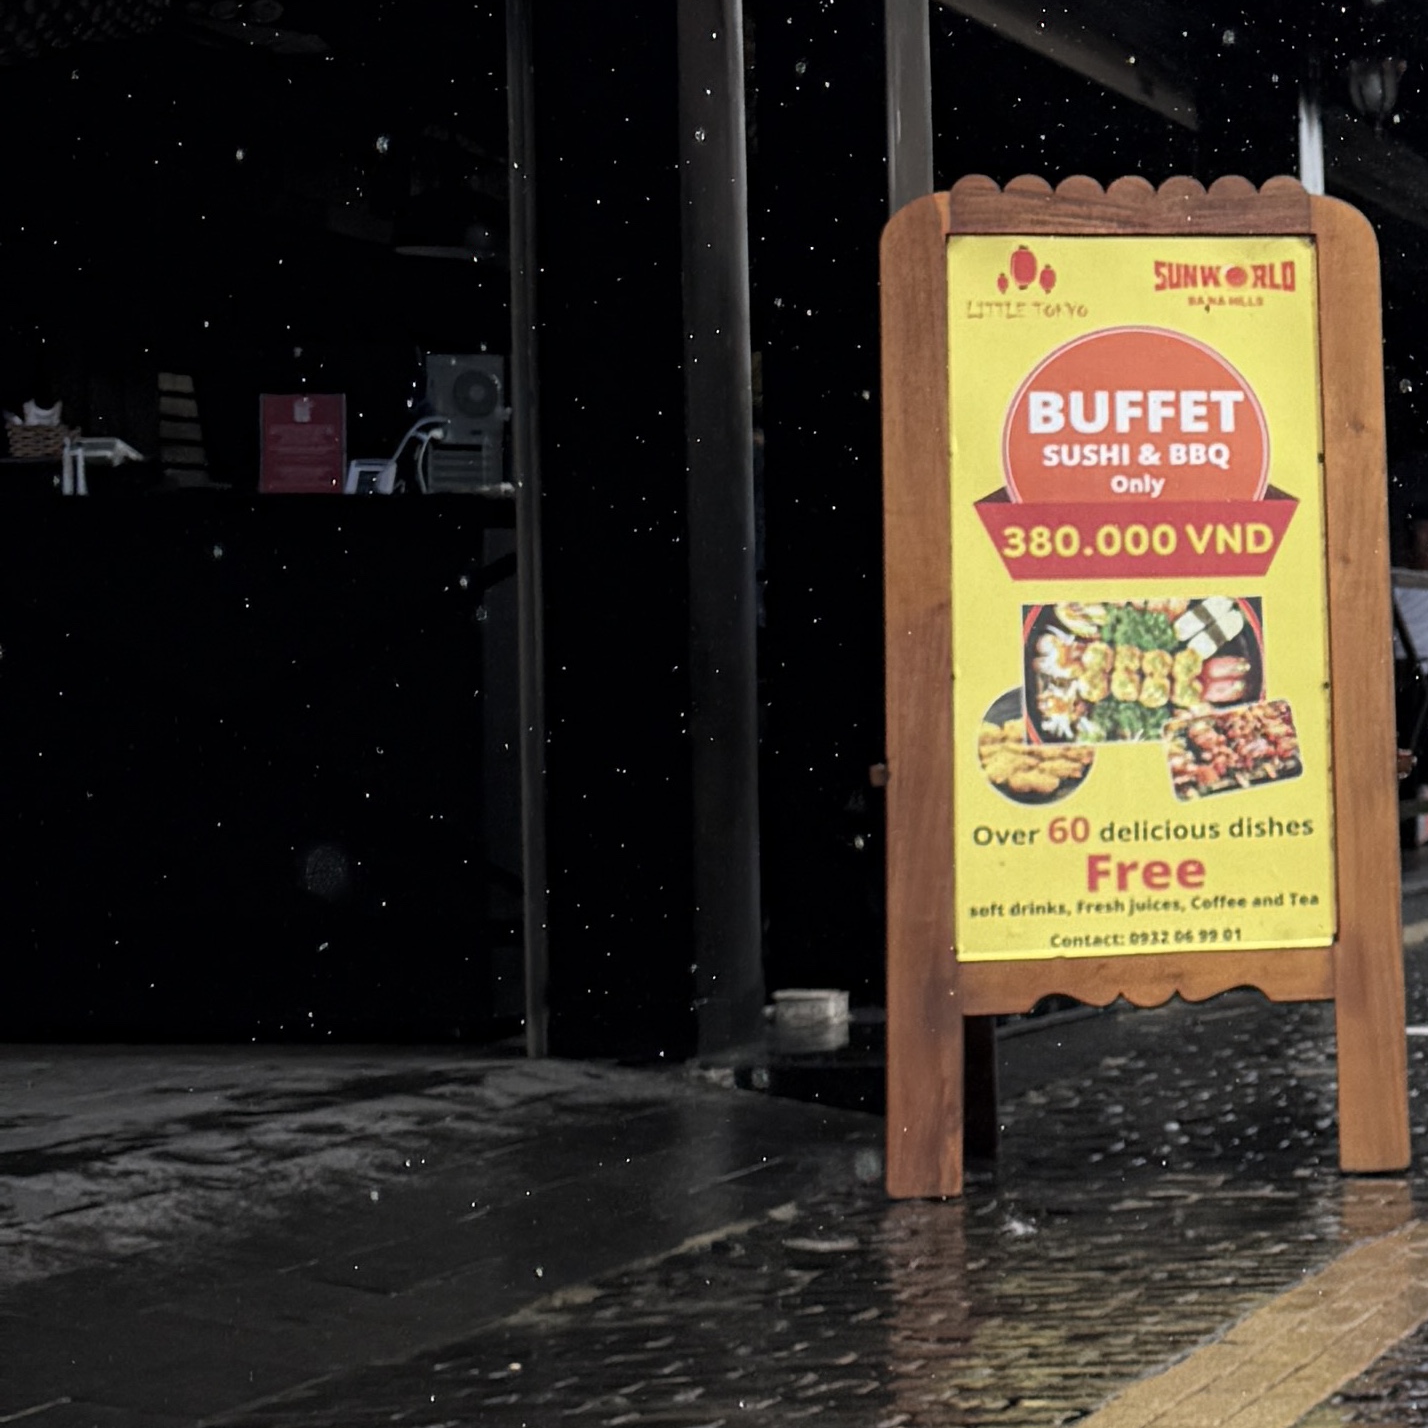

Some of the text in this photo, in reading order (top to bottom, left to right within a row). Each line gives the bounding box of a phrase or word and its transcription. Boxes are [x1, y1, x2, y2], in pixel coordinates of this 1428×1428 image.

[1028, 390, 1245, 435] BUFFET
[1042, 443, 1231, 469] SUSHI & BBQ
[1110, 474, 1166, 498] Only
[1002, 523, 1274, 558] 380.000 VND
[972, 816, 1314, 846] Over 60 delicious dishes
[1086, 853, 1207, 893] Free
[969, 902, 1005, 918] soft
[1010, 900, 1072, 919] drinks,
[1128, 896, 1186, 917] juices,
[1190, 893, 1247, 911] Coffee
[1251, 893, 1284, 908] and
[1288, 892, 1320, 907] Tea
[1049, 929, 1125, 949] Contact:
[1222, 926, 1243, 942] 01
